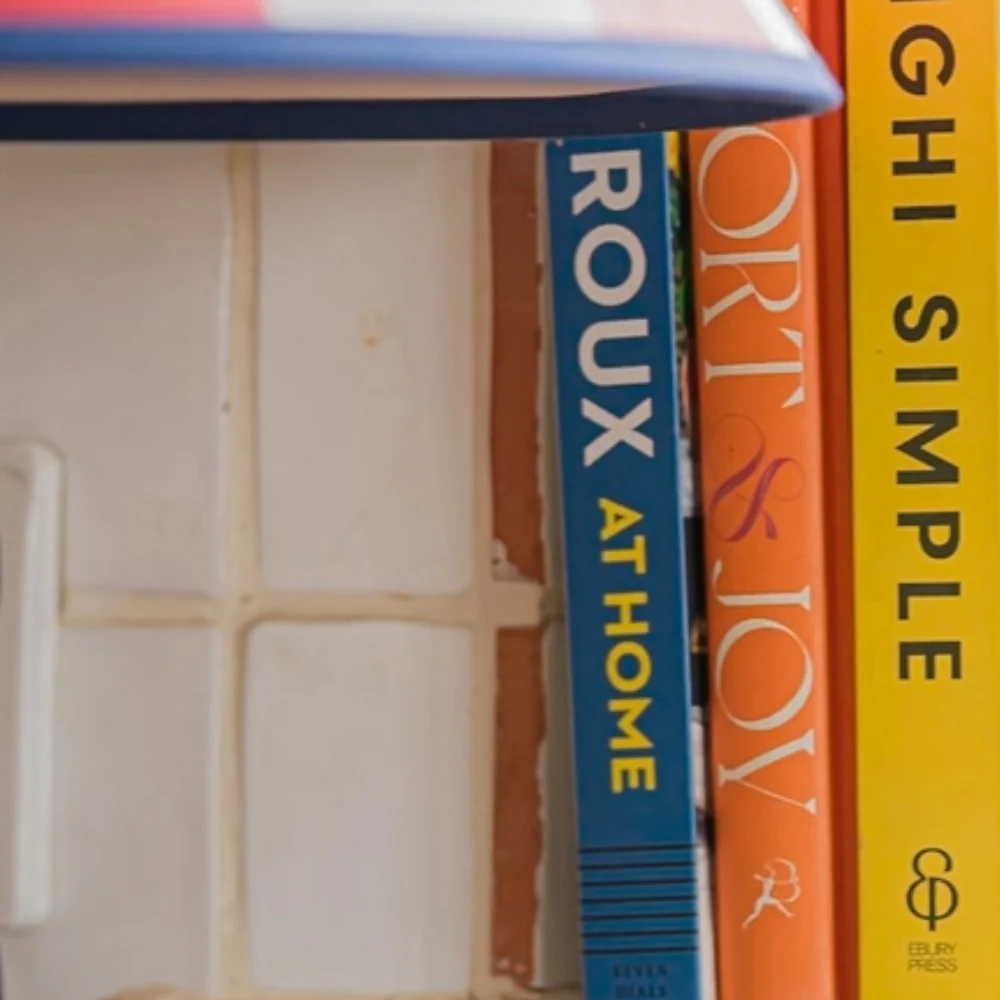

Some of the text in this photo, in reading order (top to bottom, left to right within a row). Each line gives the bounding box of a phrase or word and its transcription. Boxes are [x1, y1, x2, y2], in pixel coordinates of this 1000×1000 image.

[888, 0, 963, 681] GHI SIMPLE
[569, 148, 657, 794] ROUX AT HOME
[711, 560, 817, 815] JOY
[908, 941, 958, 956] EBURY
[908, 959, 958, 973] PRESS
